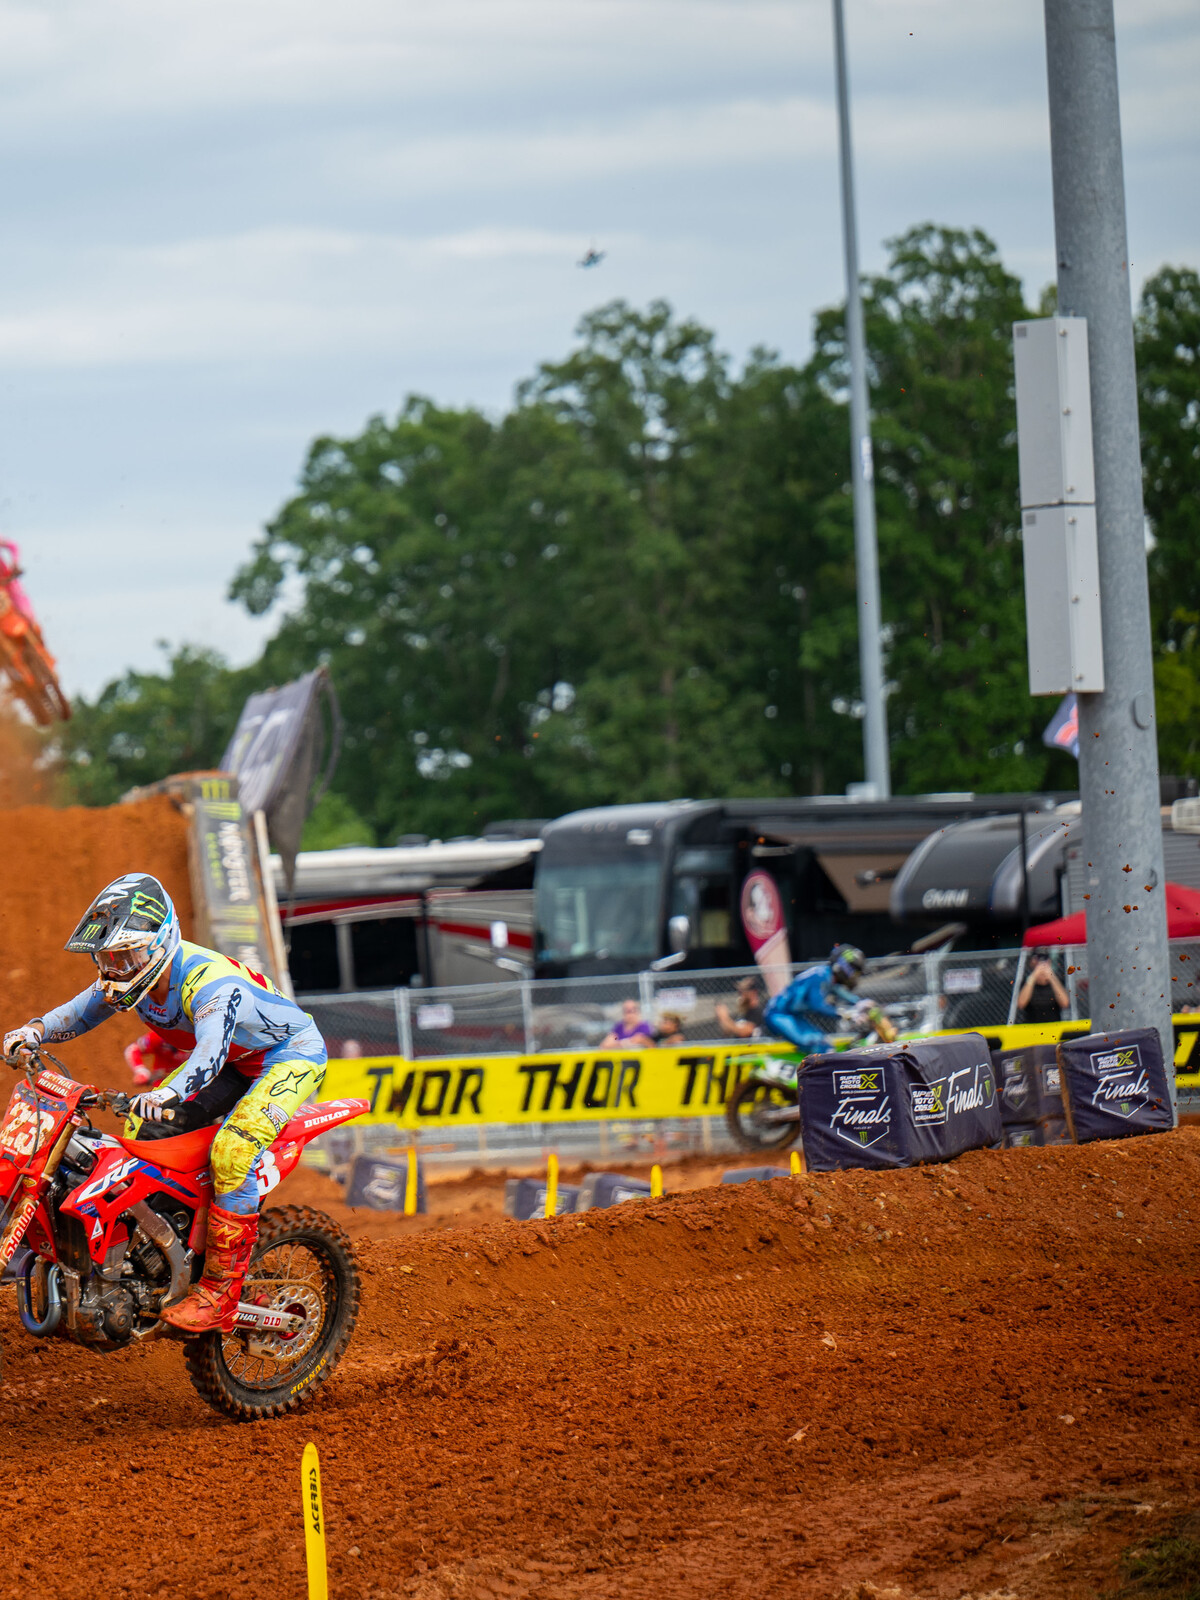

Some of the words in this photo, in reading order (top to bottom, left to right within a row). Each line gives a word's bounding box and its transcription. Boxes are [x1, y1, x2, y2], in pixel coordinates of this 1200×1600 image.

[37, 1077, 69, 1098] RENTHAL
[367, 1066, 484, 1116] THOR
[519, 1058, 641, 1112] THOR
[946, 1063, 983, 1122] Finals
[1092, 1069, 1149, 1105] Finals
[0, 1101, 55, 1156] 23
[304, 1109, 350, 1129] DUNLOP
[829, 1096, 892, 1128] Finals
[75, 1158, 139, 1203] CRF
[3, 1203, 37, 1262] SHOWA
[262, 1316, 282, 1327] DID
[290, 1358, 328, 1395] DUNLOP
[309, 1467, 321, 1535] ACERBIS
